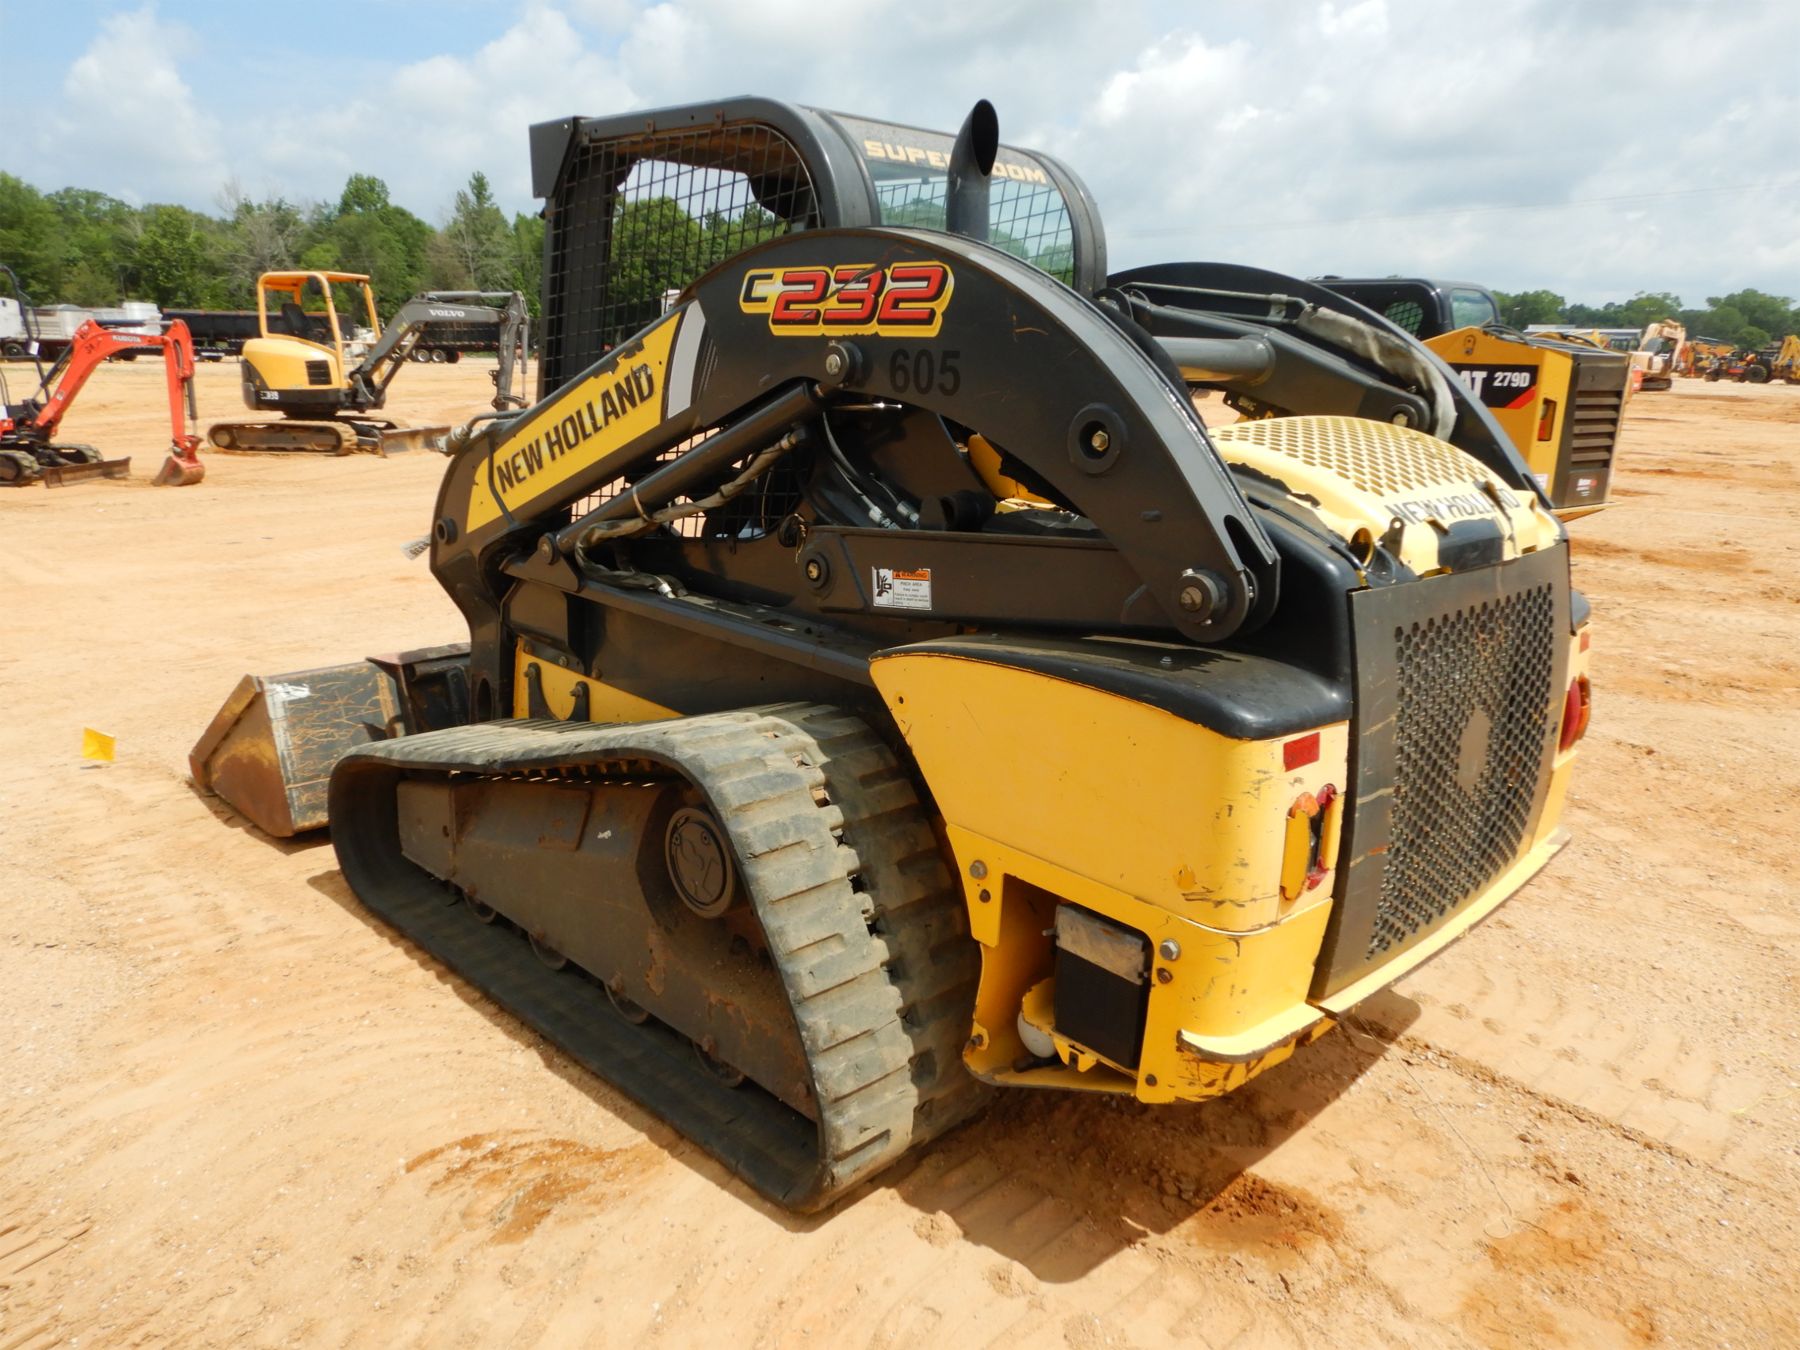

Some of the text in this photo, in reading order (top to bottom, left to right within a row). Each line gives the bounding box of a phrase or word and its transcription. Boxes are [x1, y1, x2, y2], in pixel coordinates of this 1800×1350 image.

[864, 140, 1047, 185] SUPE OOM
[429, 309, 466, 318] VOLVO
[742, 263, 951, 328] C232
[889, 349, 961, 396] 605
[1458, 370, 1531, 400] AT 279D
[496, 363, 655, 494] NEW HOLLAND
[1384, 499, 1446, 526] NEW
